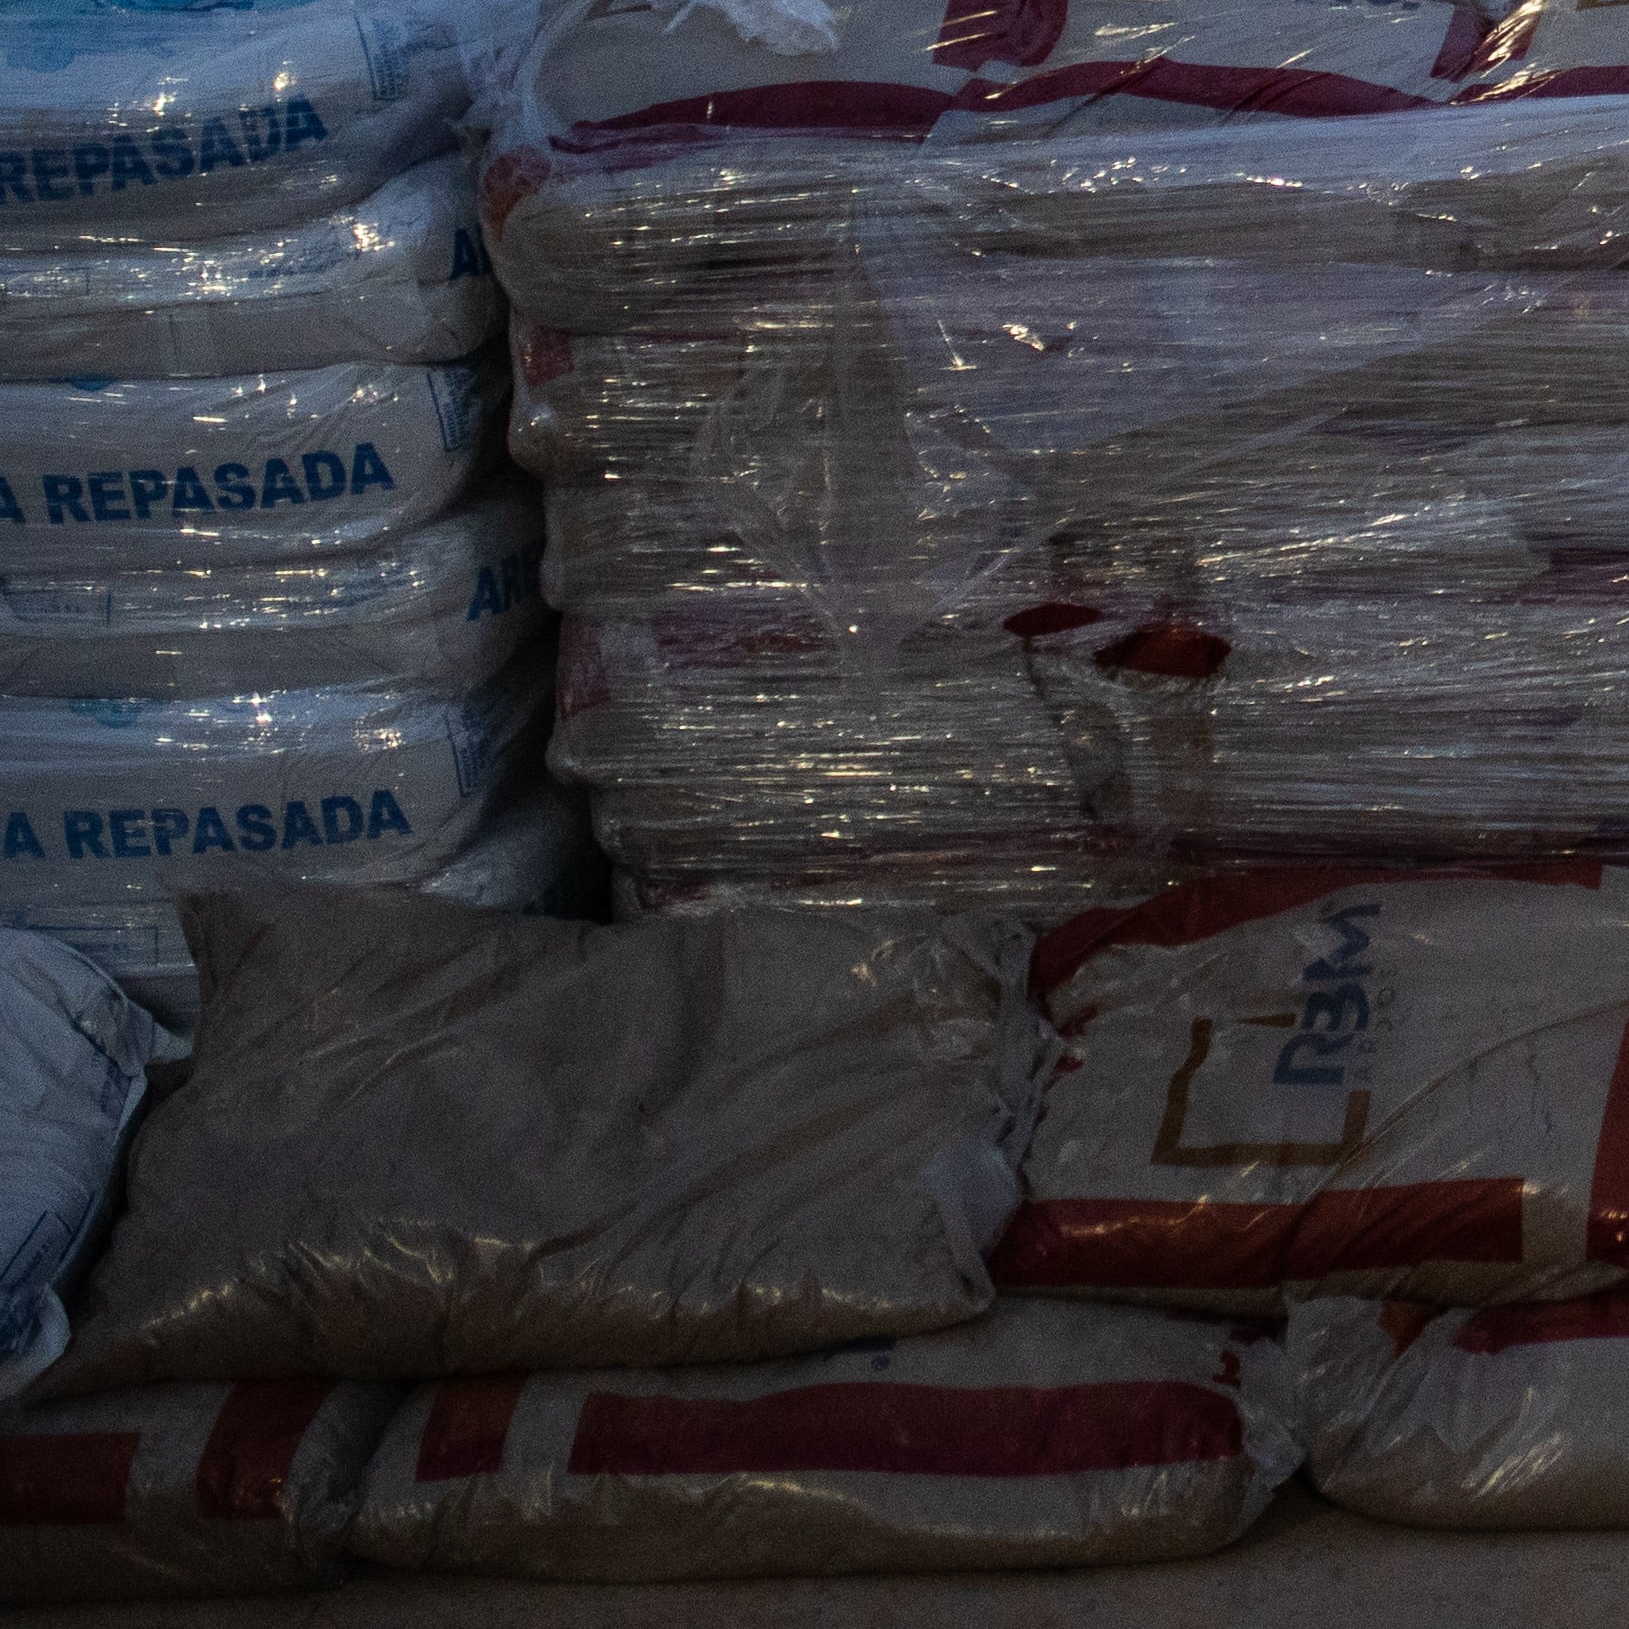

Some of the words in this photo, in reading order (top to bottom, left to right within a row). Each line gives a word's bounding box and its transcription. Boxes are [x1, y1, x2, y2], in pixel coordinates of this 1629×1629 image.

[0, 98, 327, 205] REPASADA
[44, 443, 395, 525] REPASADA
[65, 789, 412, 860] REPASADA
[1272, 903, 1381, 1087] RBM
